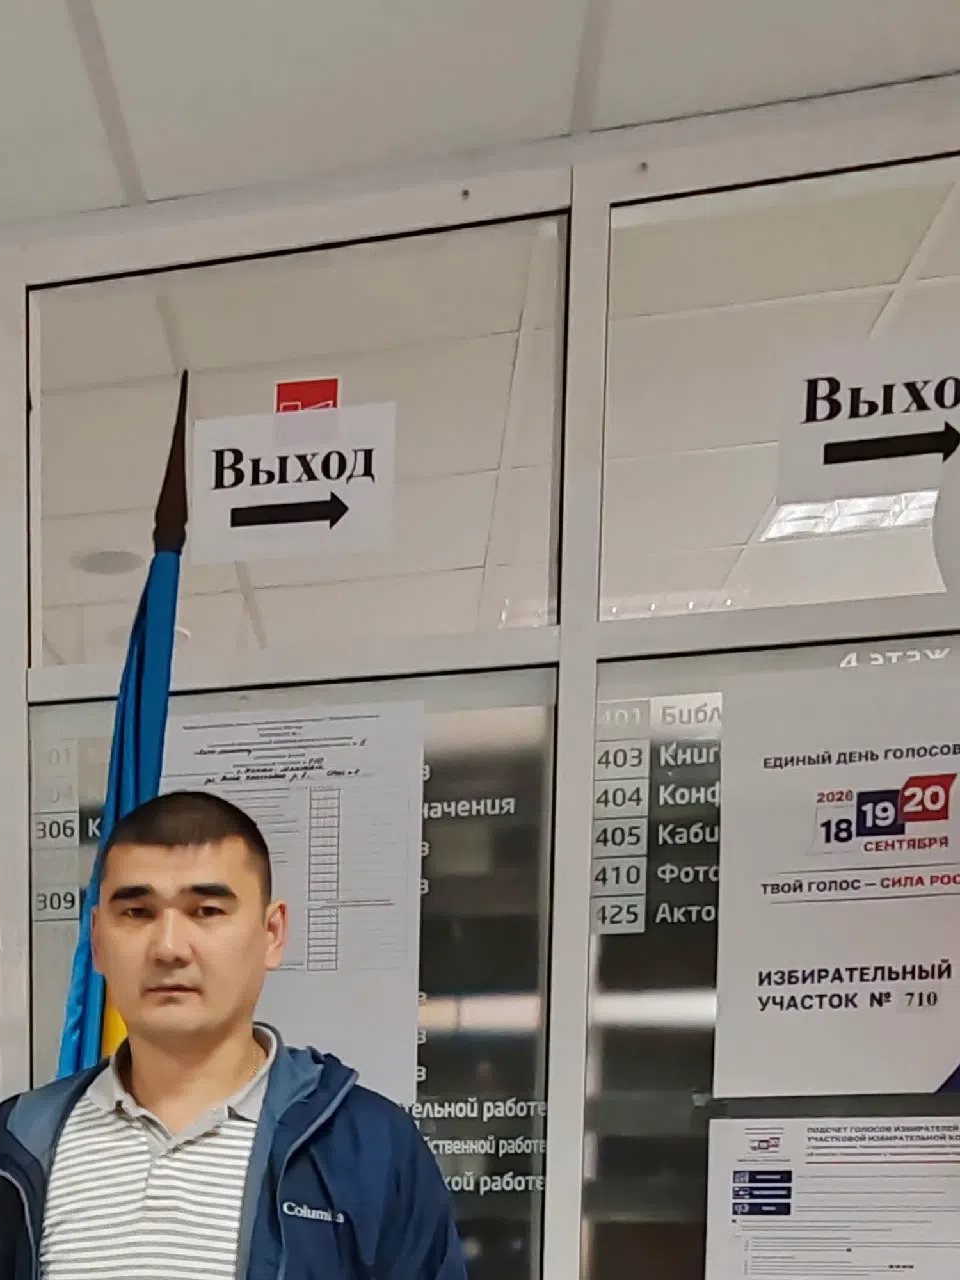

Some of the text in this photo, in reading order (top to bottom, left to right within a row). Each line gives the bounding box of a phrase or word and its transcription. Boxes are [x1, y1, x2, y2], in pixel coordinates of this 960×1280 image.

[800, 376, 960, 424] Выхо
[211, 446, 375, 490] Выход
[662, 703, 721, 724] Библ
[597, 745, 720, 769] 403 Книг
[763, 743, 960, 769] ЕДИНЫЙ ДЕНЬ ГОЛОСОВ
[596, 781, 720, 807] 404 Конф
[903, 785, 946, 813] 20
[861, 802, 896, 828] 19
[36, 820, 75, 839] 306
[595, 822, 719, 846] 405 Каби
[820, 818, 853, 843] 18
[864, 836, 949, 852] СЕНТЯБРЯ
[594, 862, 719, 885] 410 Фото
[760, 879, 803, 895] ТВОЙ
[807, 879, 861, 895] ГОЛОС
[880, 875, 925, 889] СИЛА
[930, 873, 960, 886] РОС
[37, 891, 75, 911] 309
[597, 903, 716, 925] 425 Акто
[757, 959, 952, 987] ИЗБИРАТЕЛЬНЫЙ
[758, 991, 938, 1012] УЧАСТОК № 710
[407, 1097, 546, 1122] ельной работе
[499, 1136, 546, 1158] работе
[480, 1171, 544, 1196] работе
